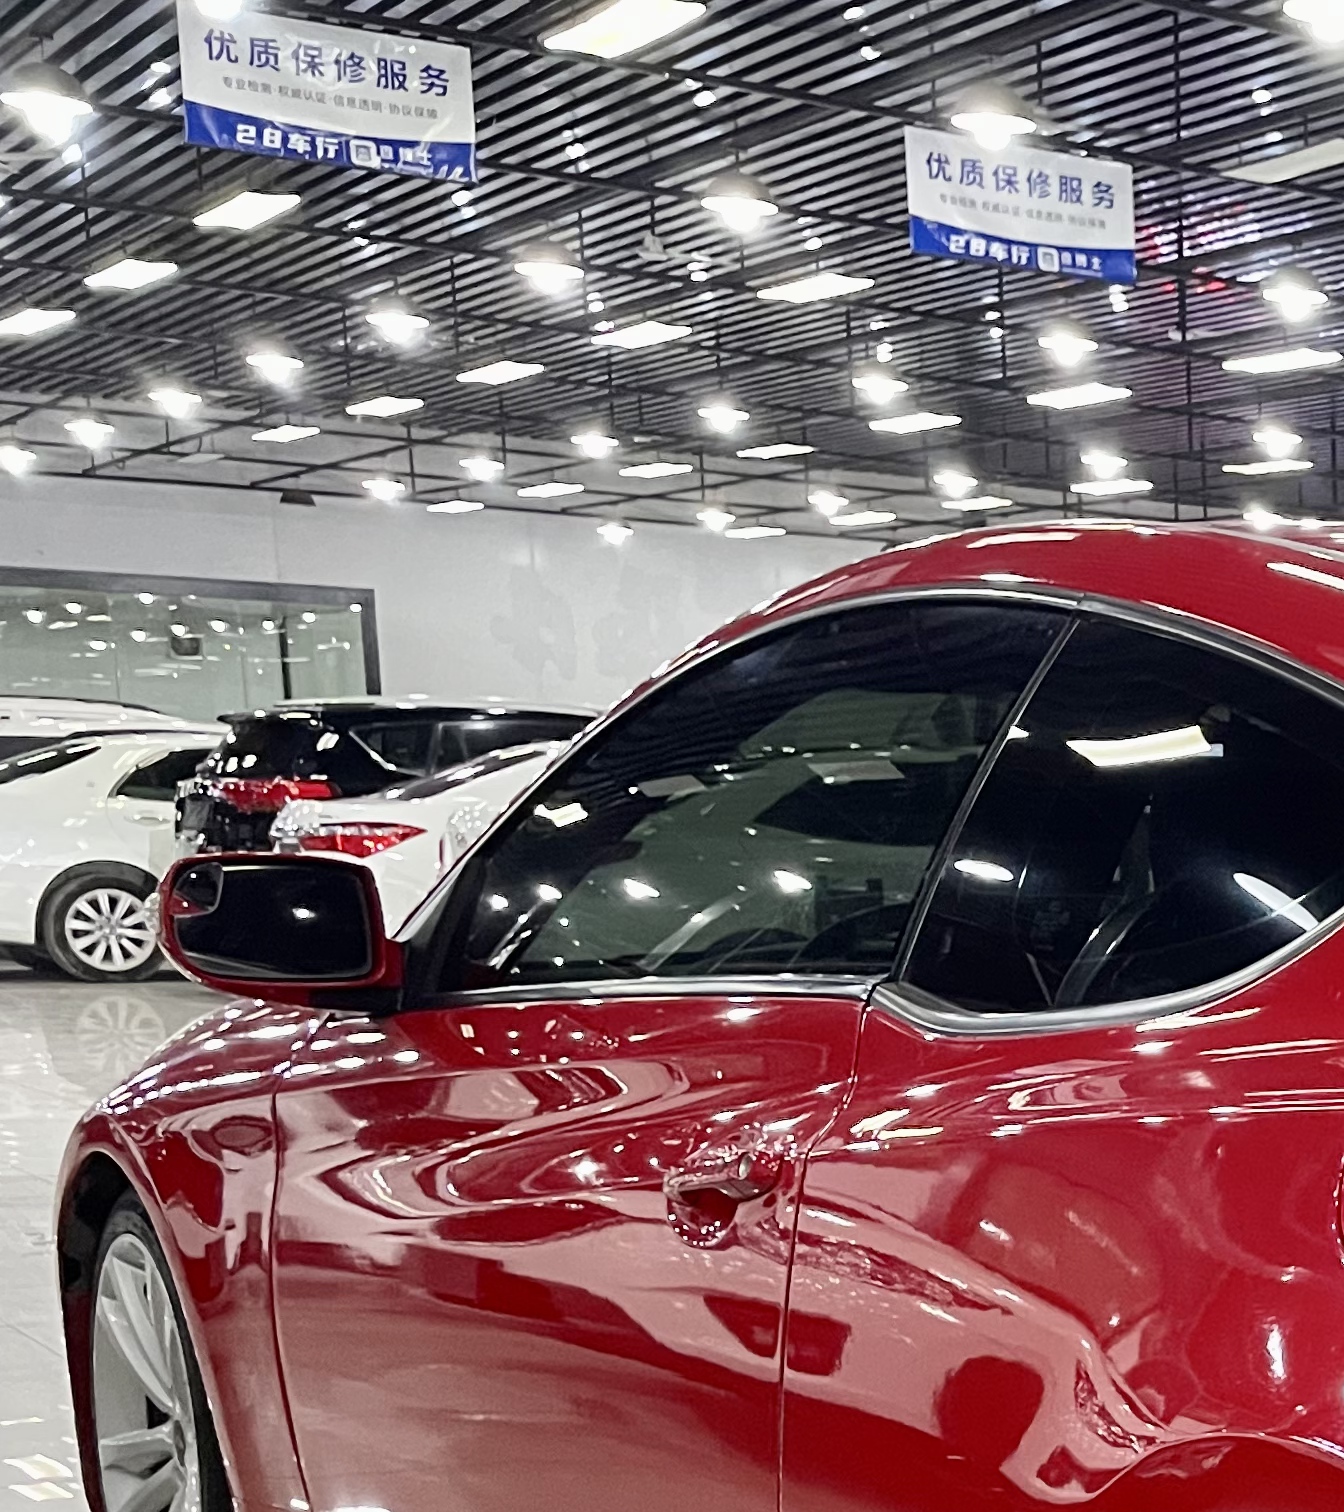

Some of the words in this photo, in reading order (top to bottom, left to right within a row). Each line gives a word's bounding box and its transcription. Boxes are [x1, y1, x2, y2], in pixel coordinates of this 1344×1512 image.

[204, 28, 450, 97] 优质保修服务
[236, 124, 340, 160] 28车行
[926, 151, 1115, 210] 优质保修服务
[949, 234, 1030, 266] 28车行
